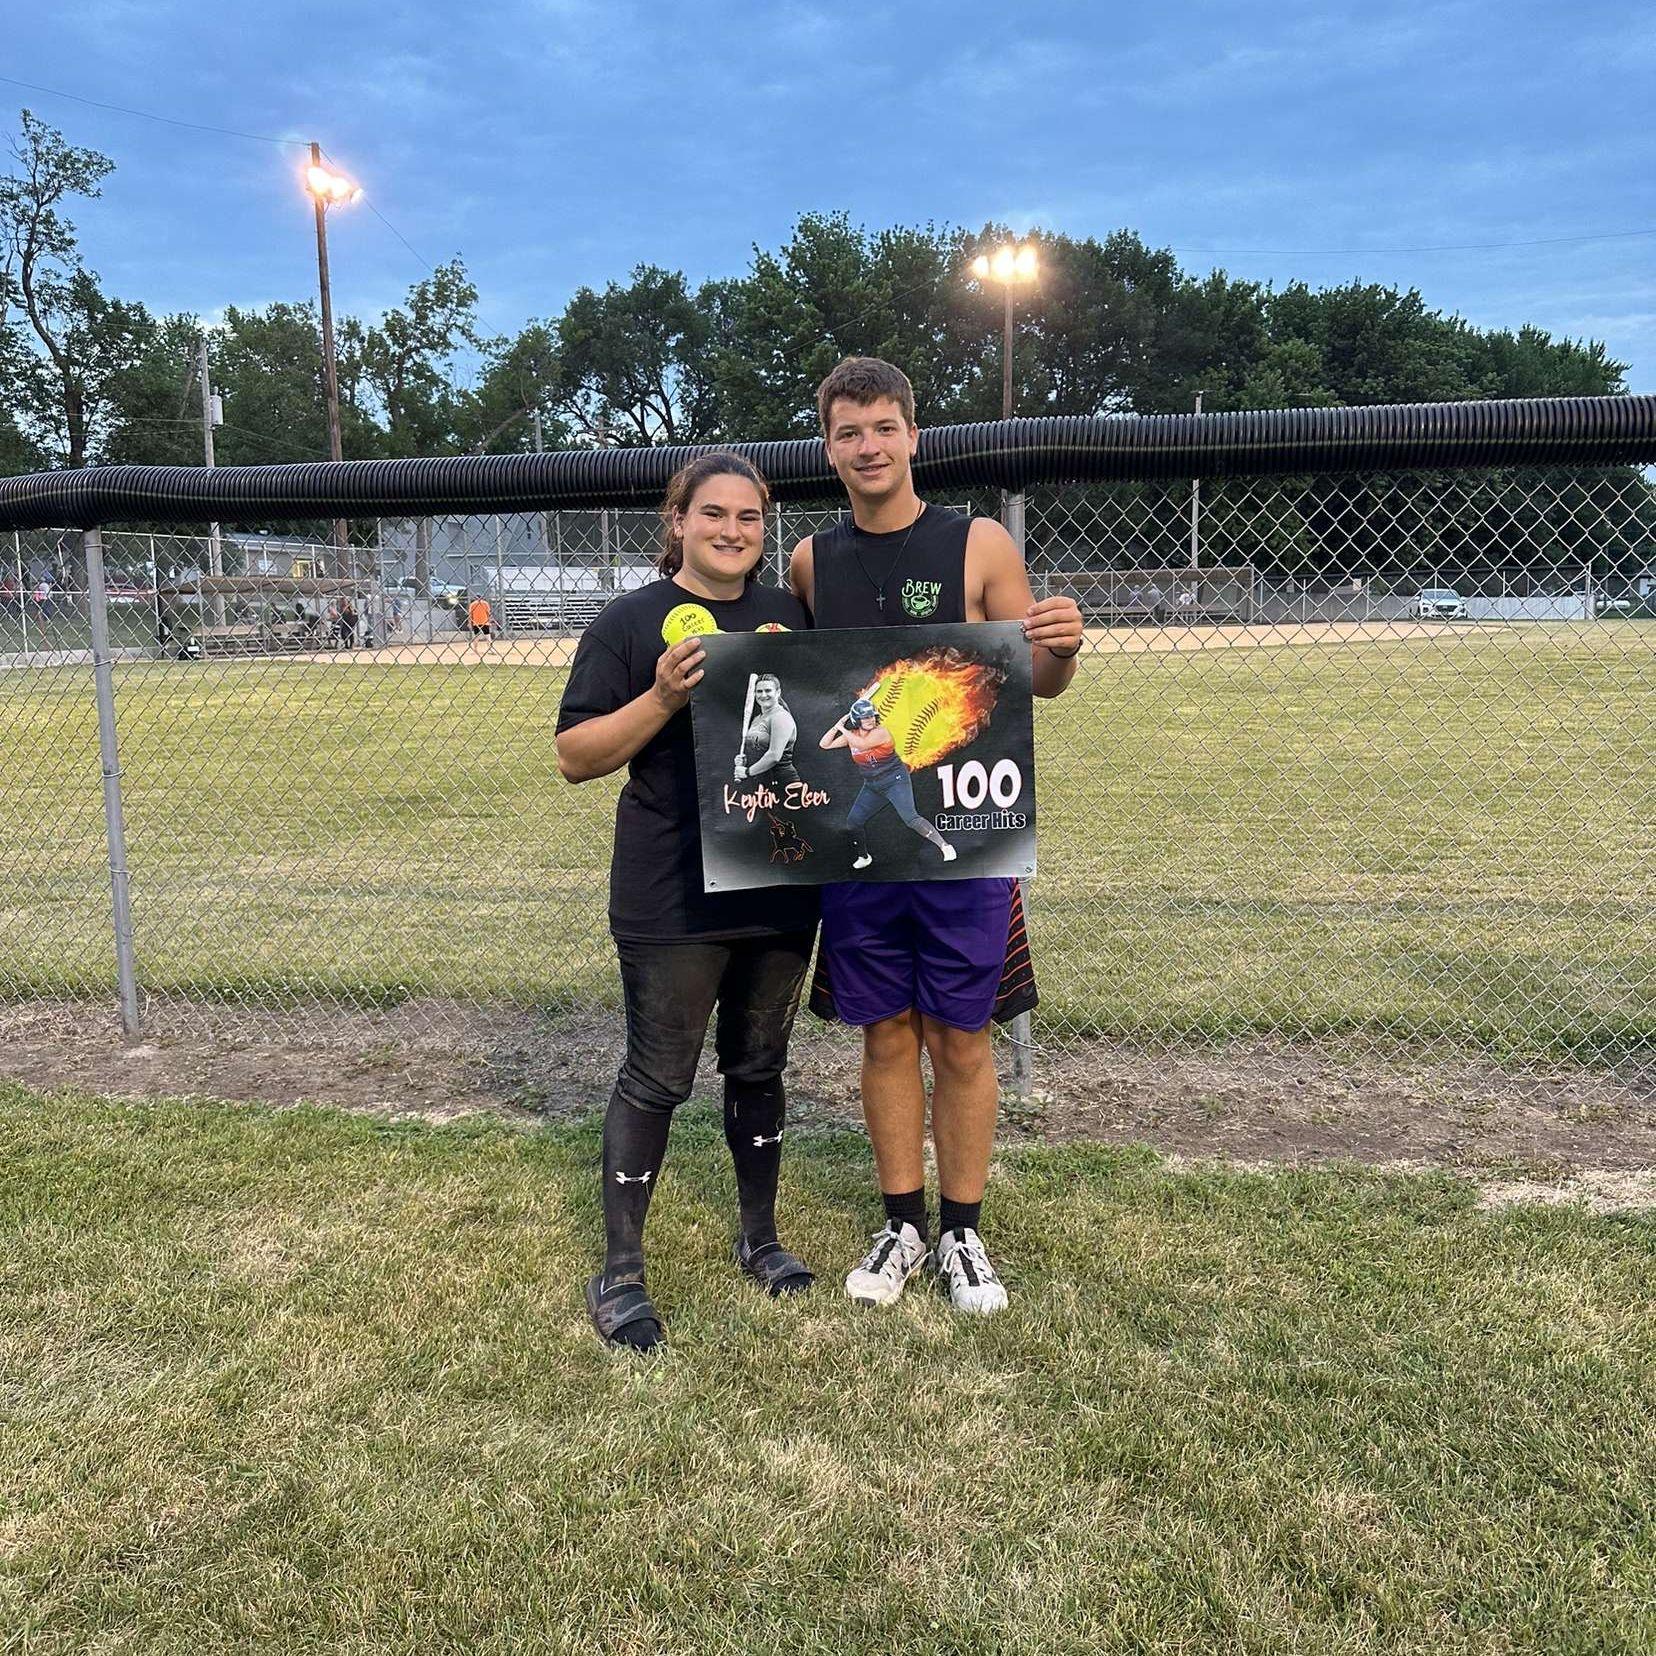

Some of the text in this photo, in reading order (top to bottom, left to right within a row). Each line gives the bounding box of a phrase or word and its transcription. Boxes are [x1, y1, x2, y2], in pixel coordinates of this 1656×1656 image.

[901, 578, 942, 597] BREW
[679, 613, 697, 626] 100
[936, 758, 1022, 810] 100
[935, 808, 1026, 831] Career Hits
